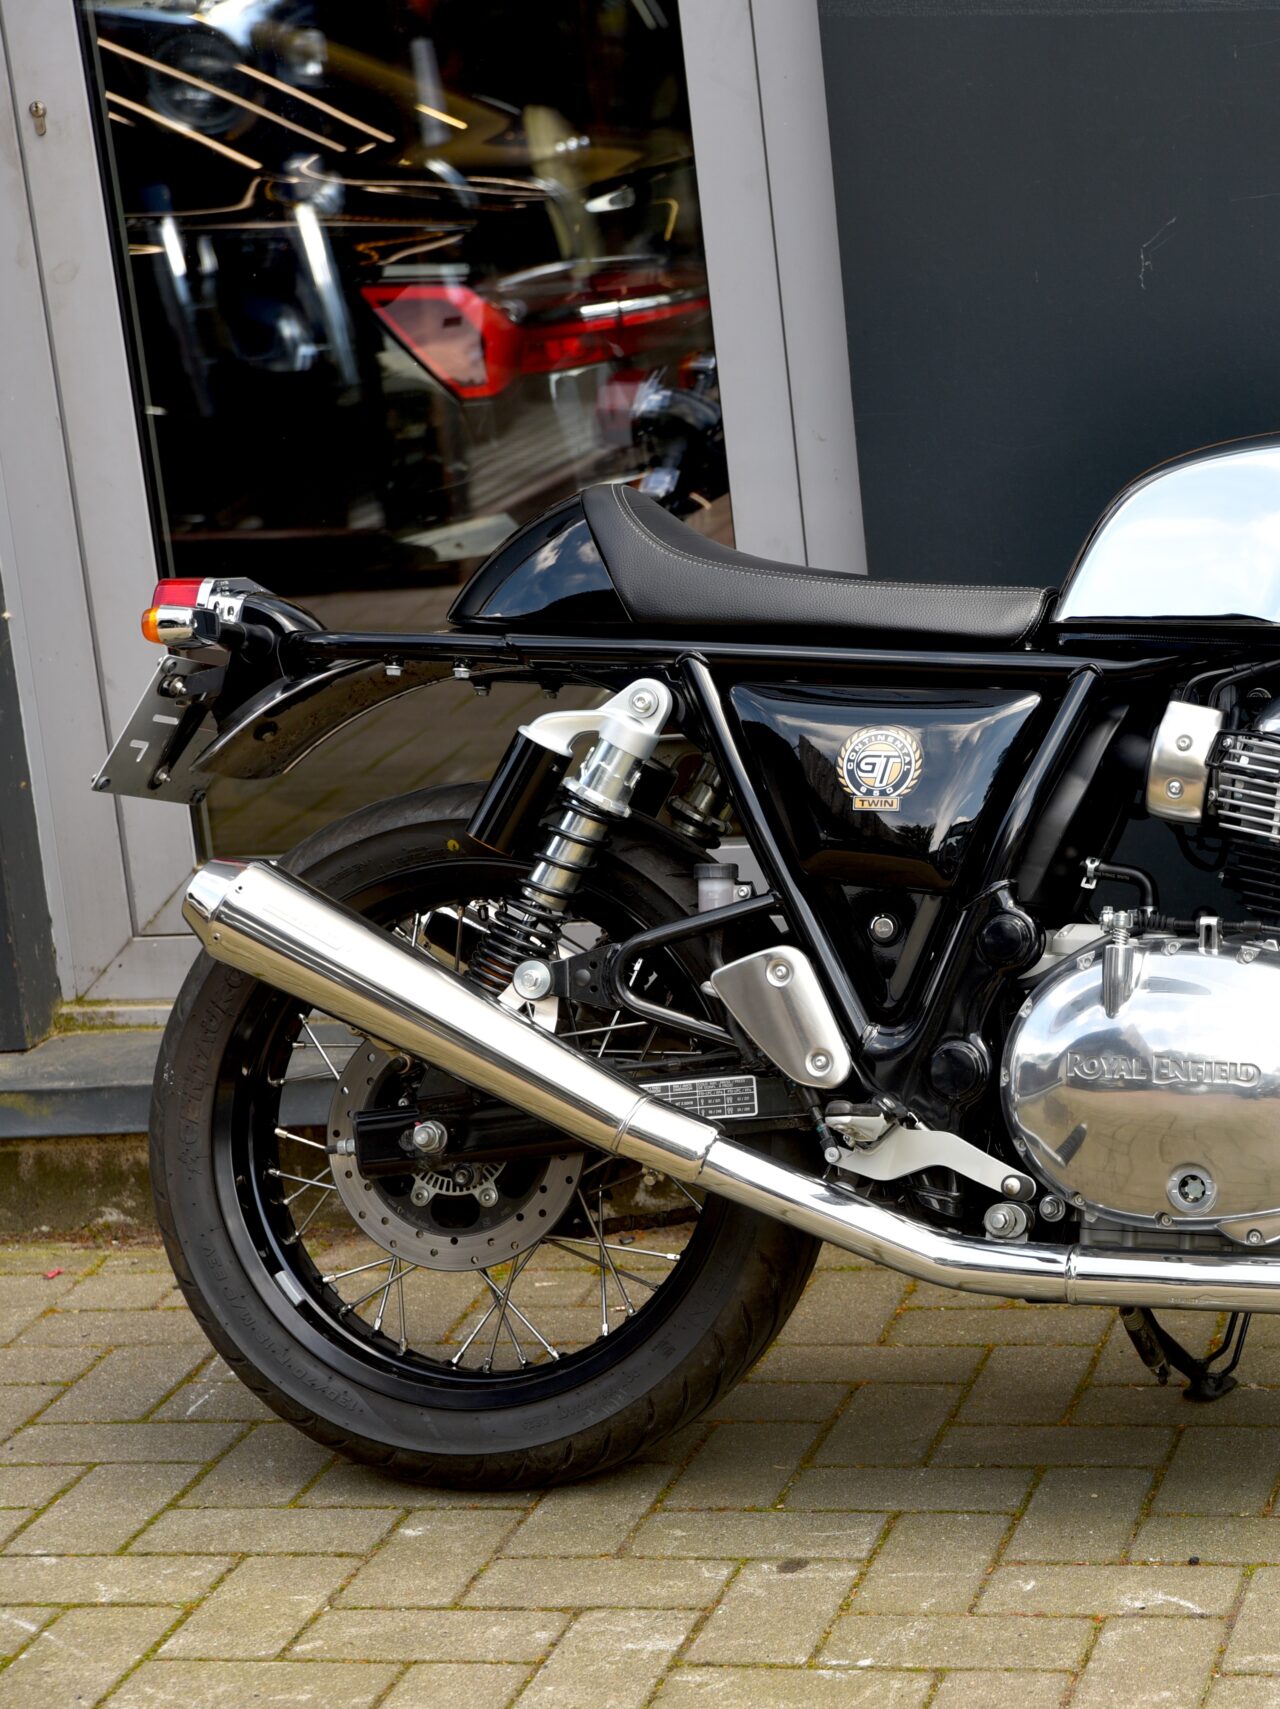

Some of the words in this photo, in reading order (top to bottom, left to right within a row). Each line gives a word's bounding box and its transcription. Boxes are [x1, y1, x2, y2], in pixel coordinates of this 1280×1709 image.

[847, 734, 911, 772] CONTINENTAL
[856, 750, 902, 787] GT
[859, 799, 894, 807] TWIN
[860, 786, 894, 796] 650
[1066, 1051, 1147, 1081] ROYAL
[1152, 1054, 1262, 1088] ENFIELD
